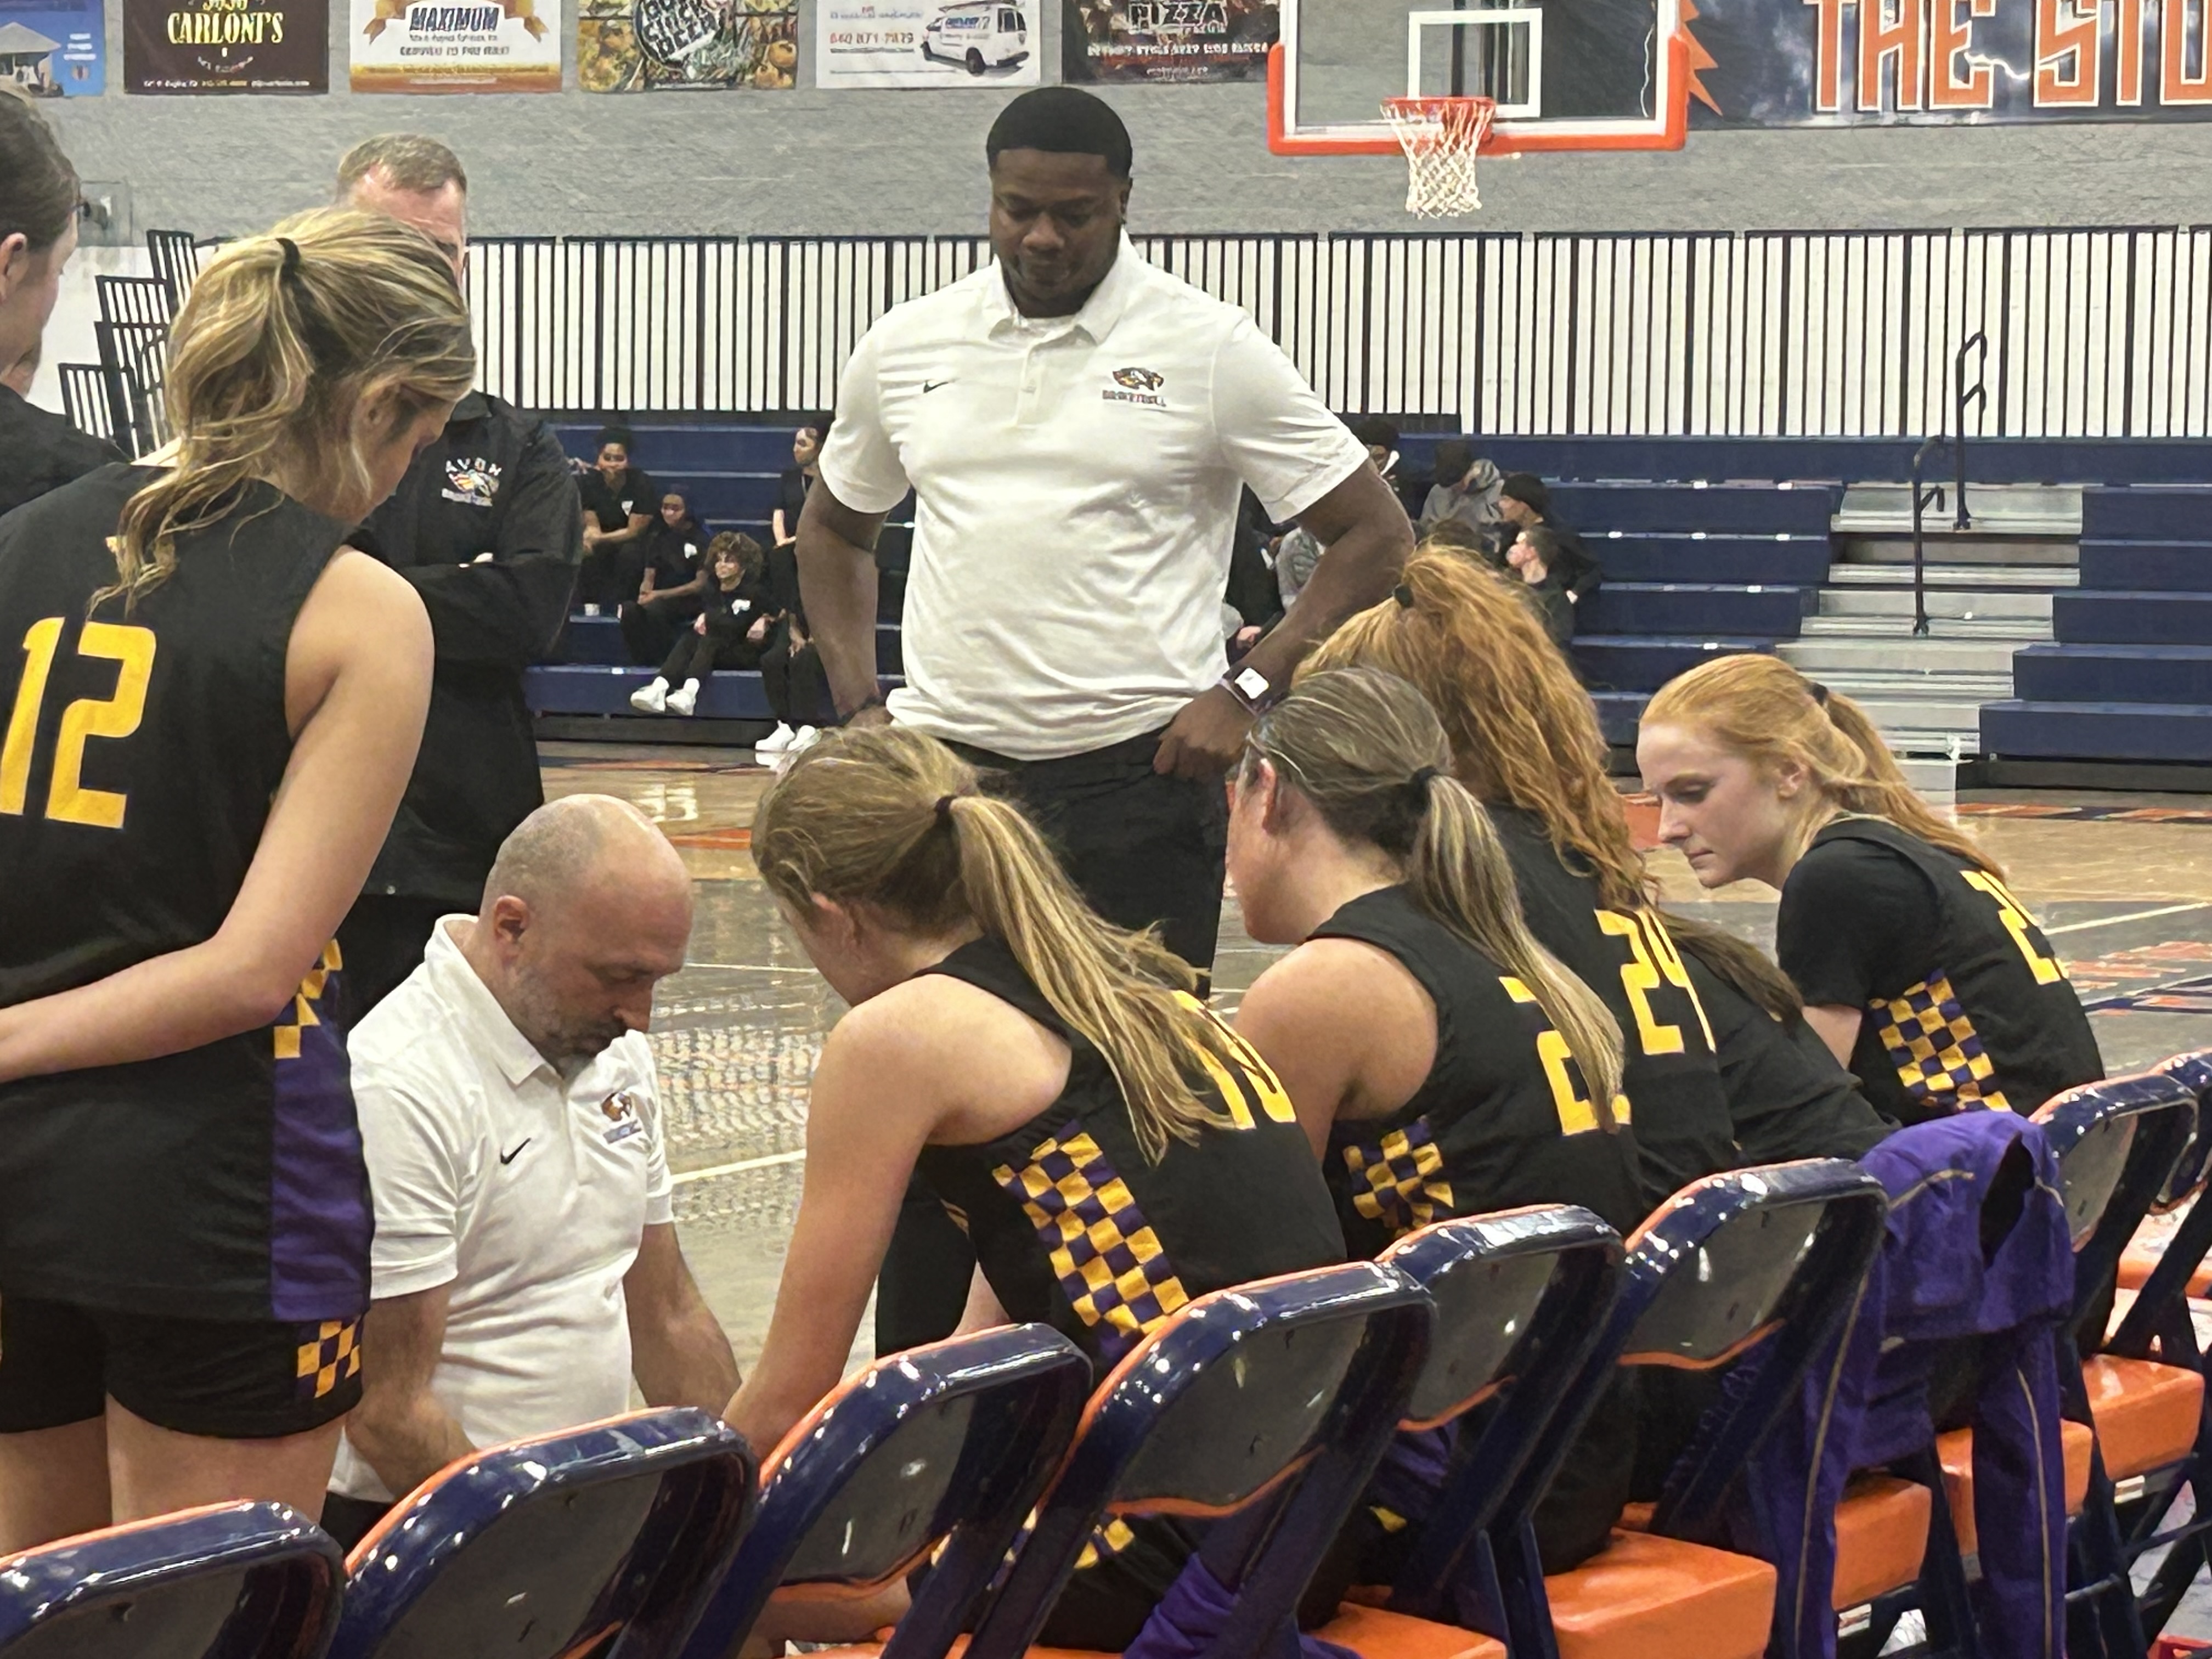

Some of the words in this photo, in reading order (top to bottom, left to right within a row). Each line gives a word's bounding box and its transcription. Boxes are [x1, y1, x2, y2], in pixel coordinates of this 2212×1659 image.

[168, 12, 284, 44] CARLONI'S
[409, 7, 499, 31] MAXIMUM
[1803, 0, 1996, 111] THE
[445, 457, 502, 476] AVON
[0, 617, 157, 829] 12
[1594, 909, 1717, 1056] 24
[1959, 870, 2069, 985] 2
[1498, 976, 1632, 1136] 2
